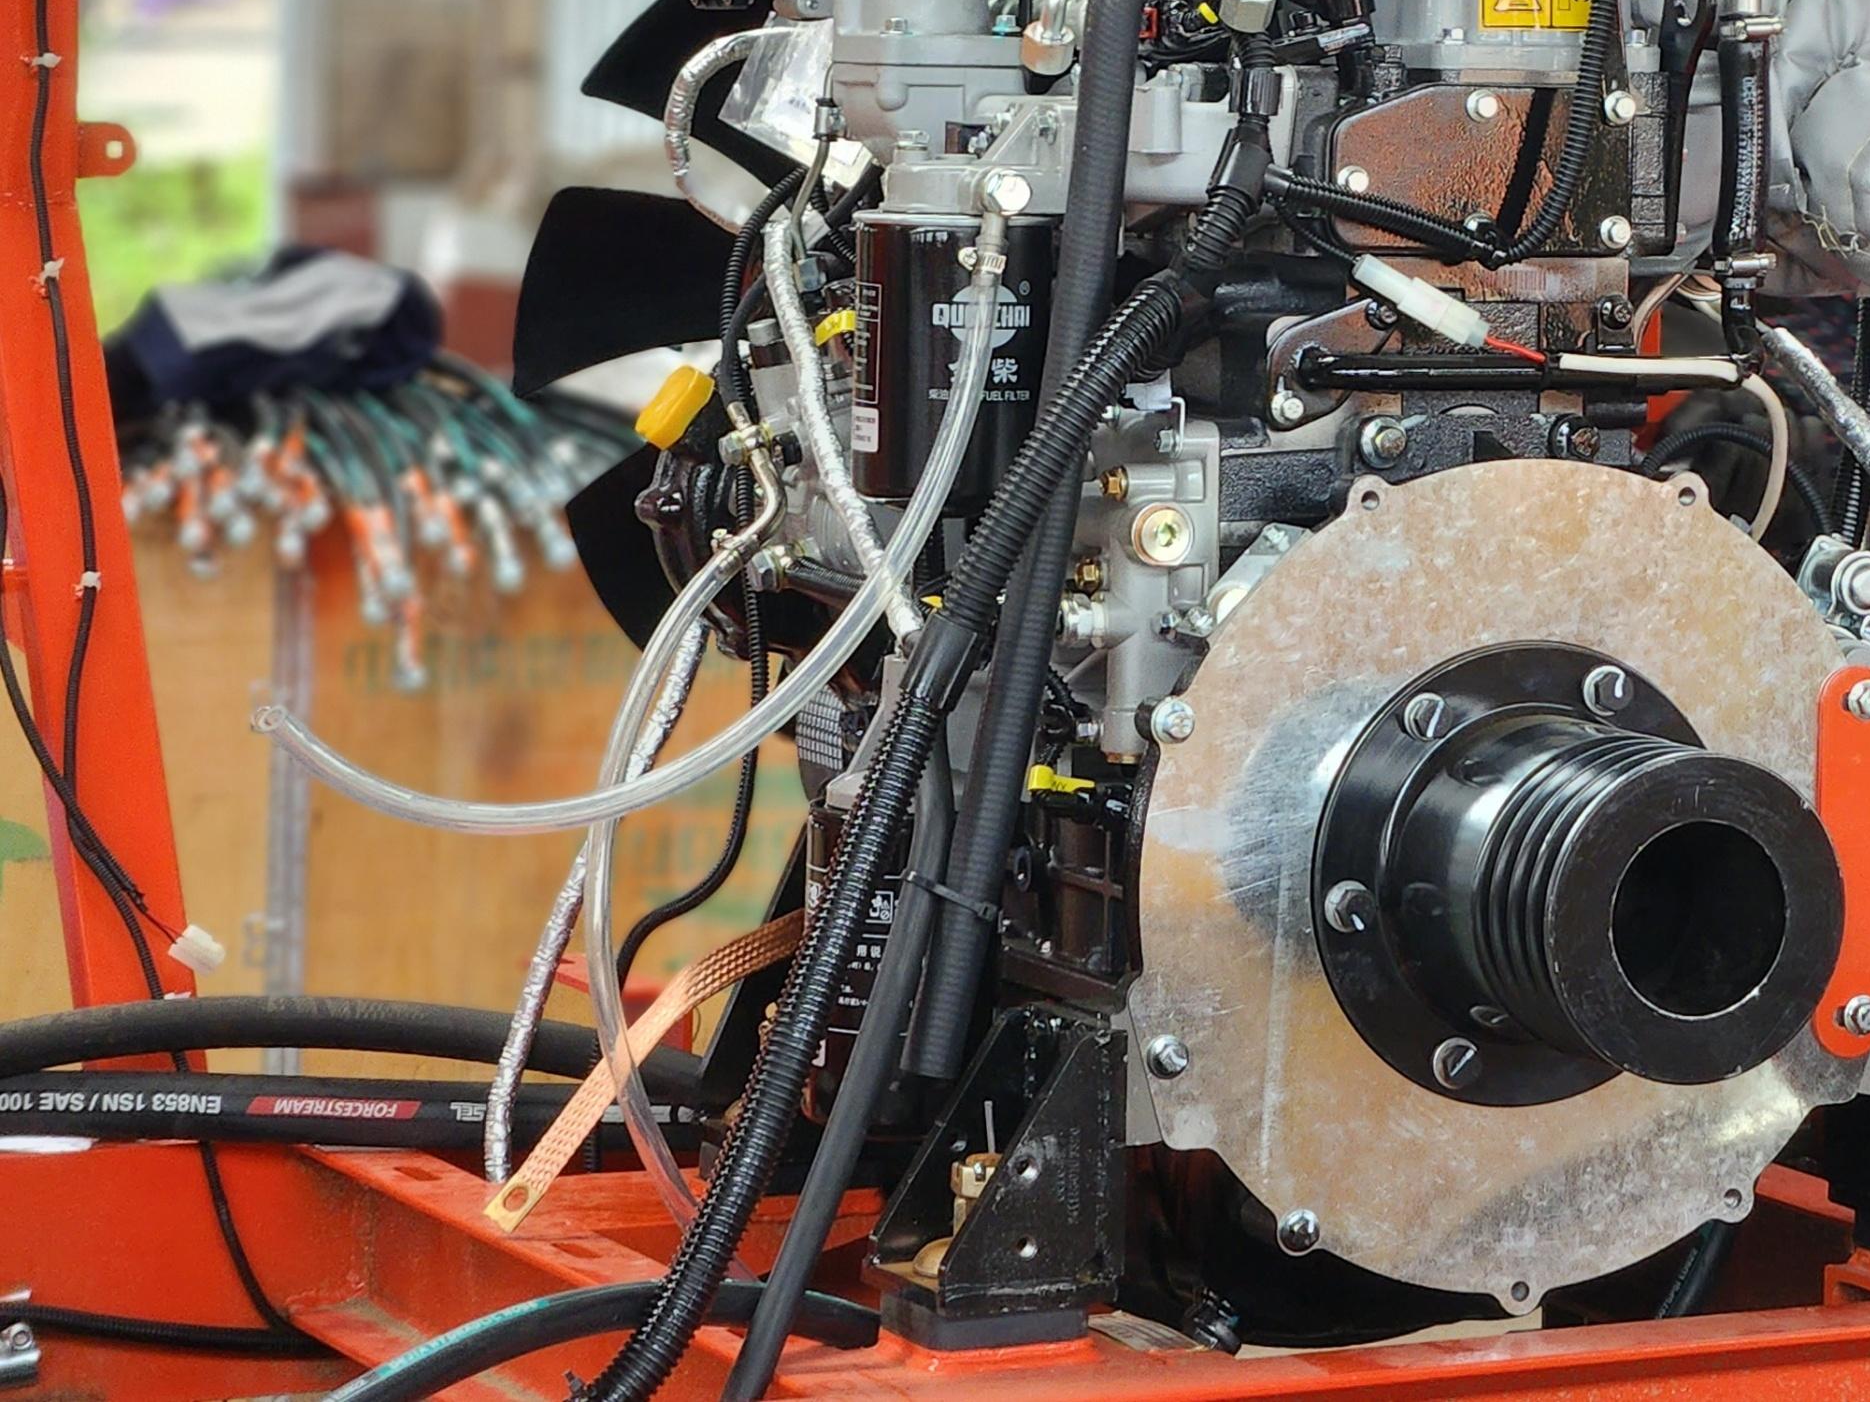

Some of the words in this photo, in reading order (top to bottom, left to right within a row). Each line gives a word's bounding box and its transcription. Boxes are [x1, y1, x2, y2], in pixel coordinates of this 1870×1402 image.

[947, 358, 1019, 384] 柴
[38, 1092, 84, 1112] SAE
[101, 1092, 146, 1112] 1SN
[151, 1093, 222, 1114] EN853
[273, 1098, 399, 1120] FORCESTREAM
